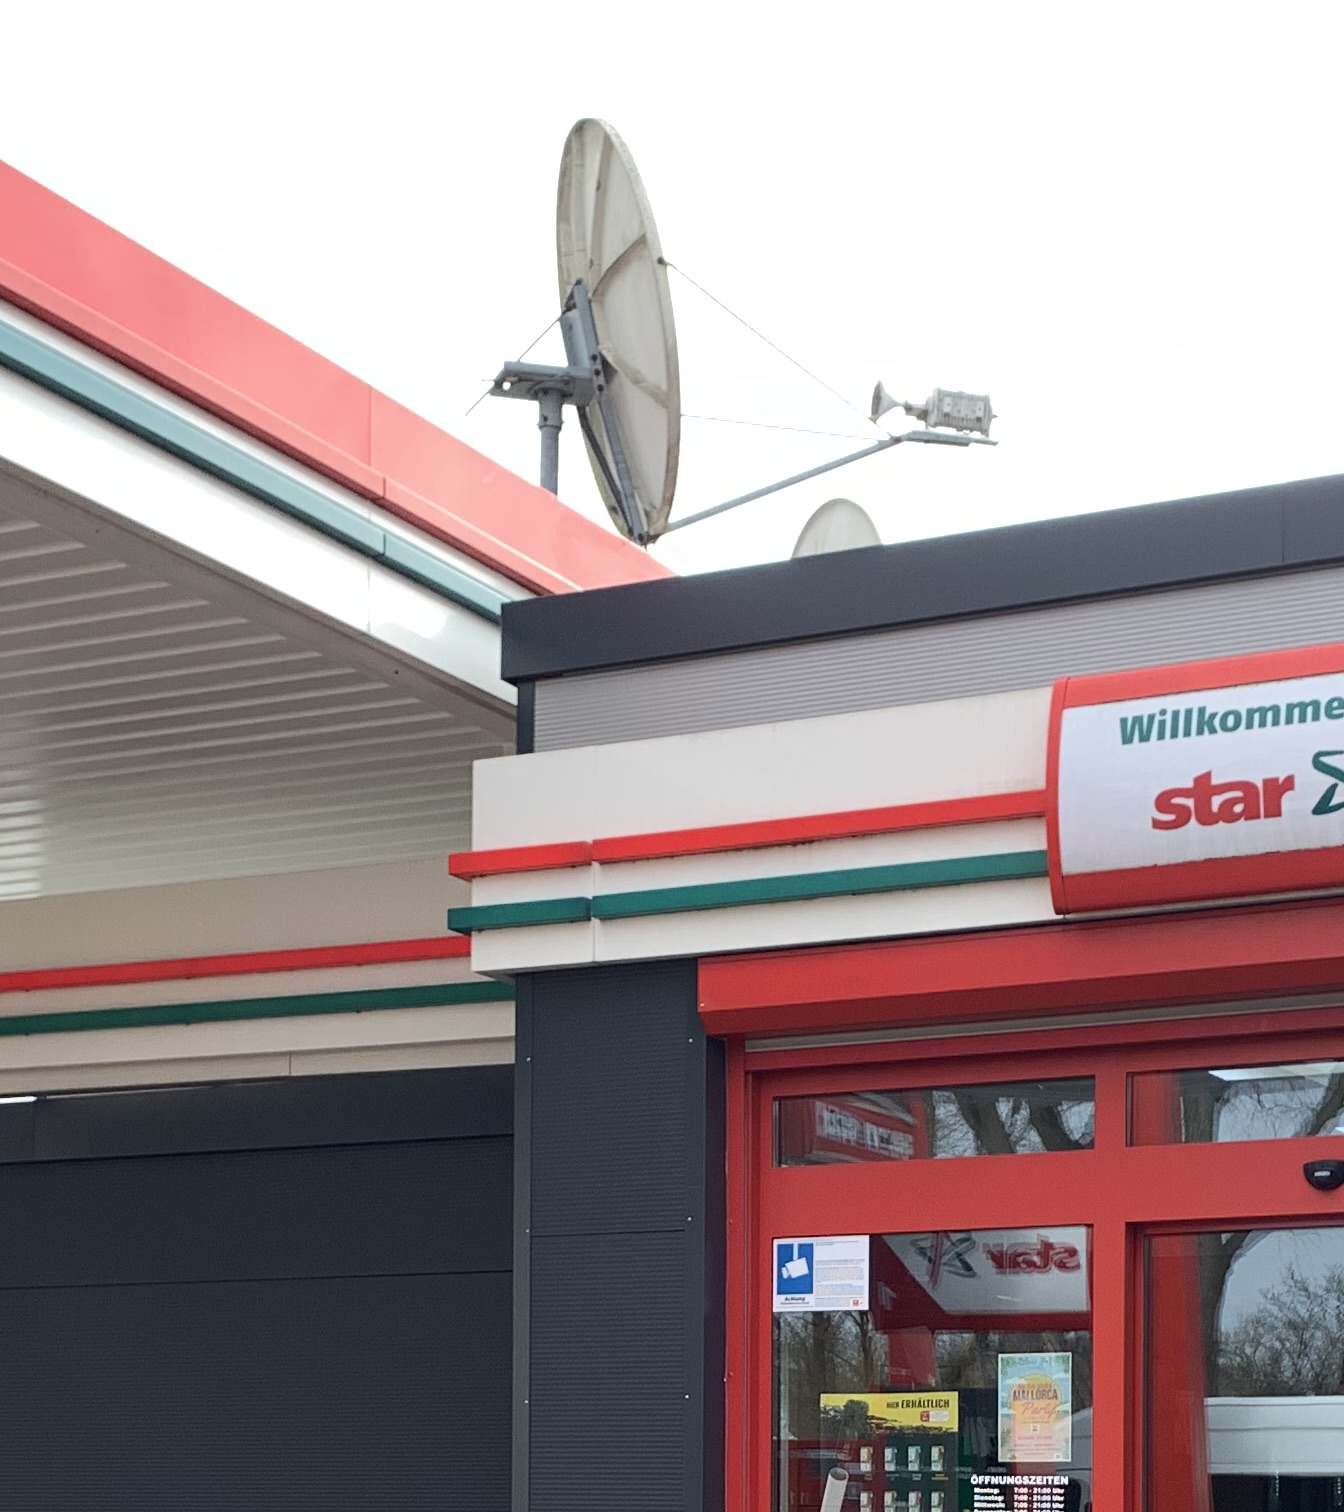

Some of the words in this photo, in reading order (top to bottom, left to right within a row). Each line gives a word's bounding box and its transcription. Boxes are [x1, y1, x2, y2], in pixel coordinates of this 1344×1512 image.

[1150, 769, 1296, 832] star
[1012, 1388, 1058, 1401] MALLORCA
[901, 1397, 950, 1409] ERHÄLTLICH
[1022, 1401, 1058, 1420] Party
[970, 1473, 1069, 1486] ÖFFNUNGSZEITEN
